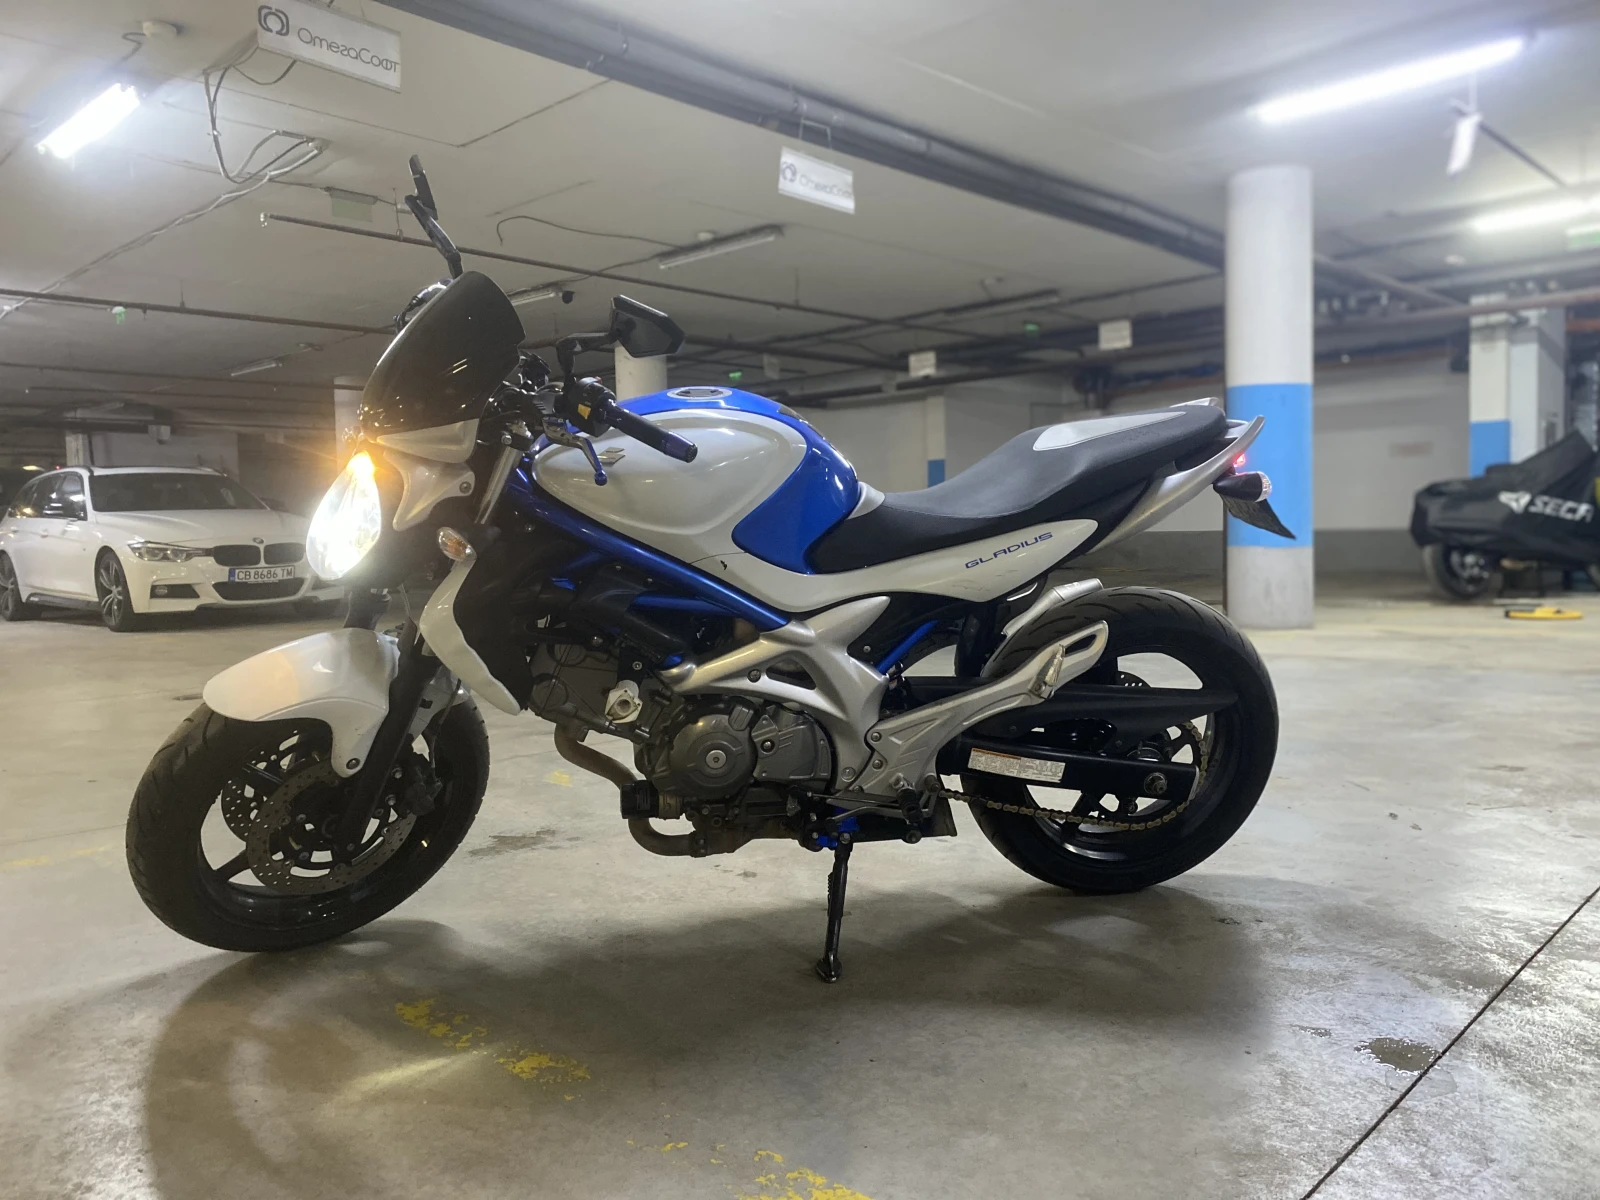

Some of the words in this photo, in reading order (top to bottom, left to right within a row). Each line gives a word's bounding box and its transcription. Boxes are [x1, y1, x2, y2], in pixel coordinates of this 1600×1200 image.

[965, 532, 1053, 569] GLADIUS
[237, 570, 251, 581] CB
[253, 569, 278, 580] 8686
[281, 567, 293, 578] TM
